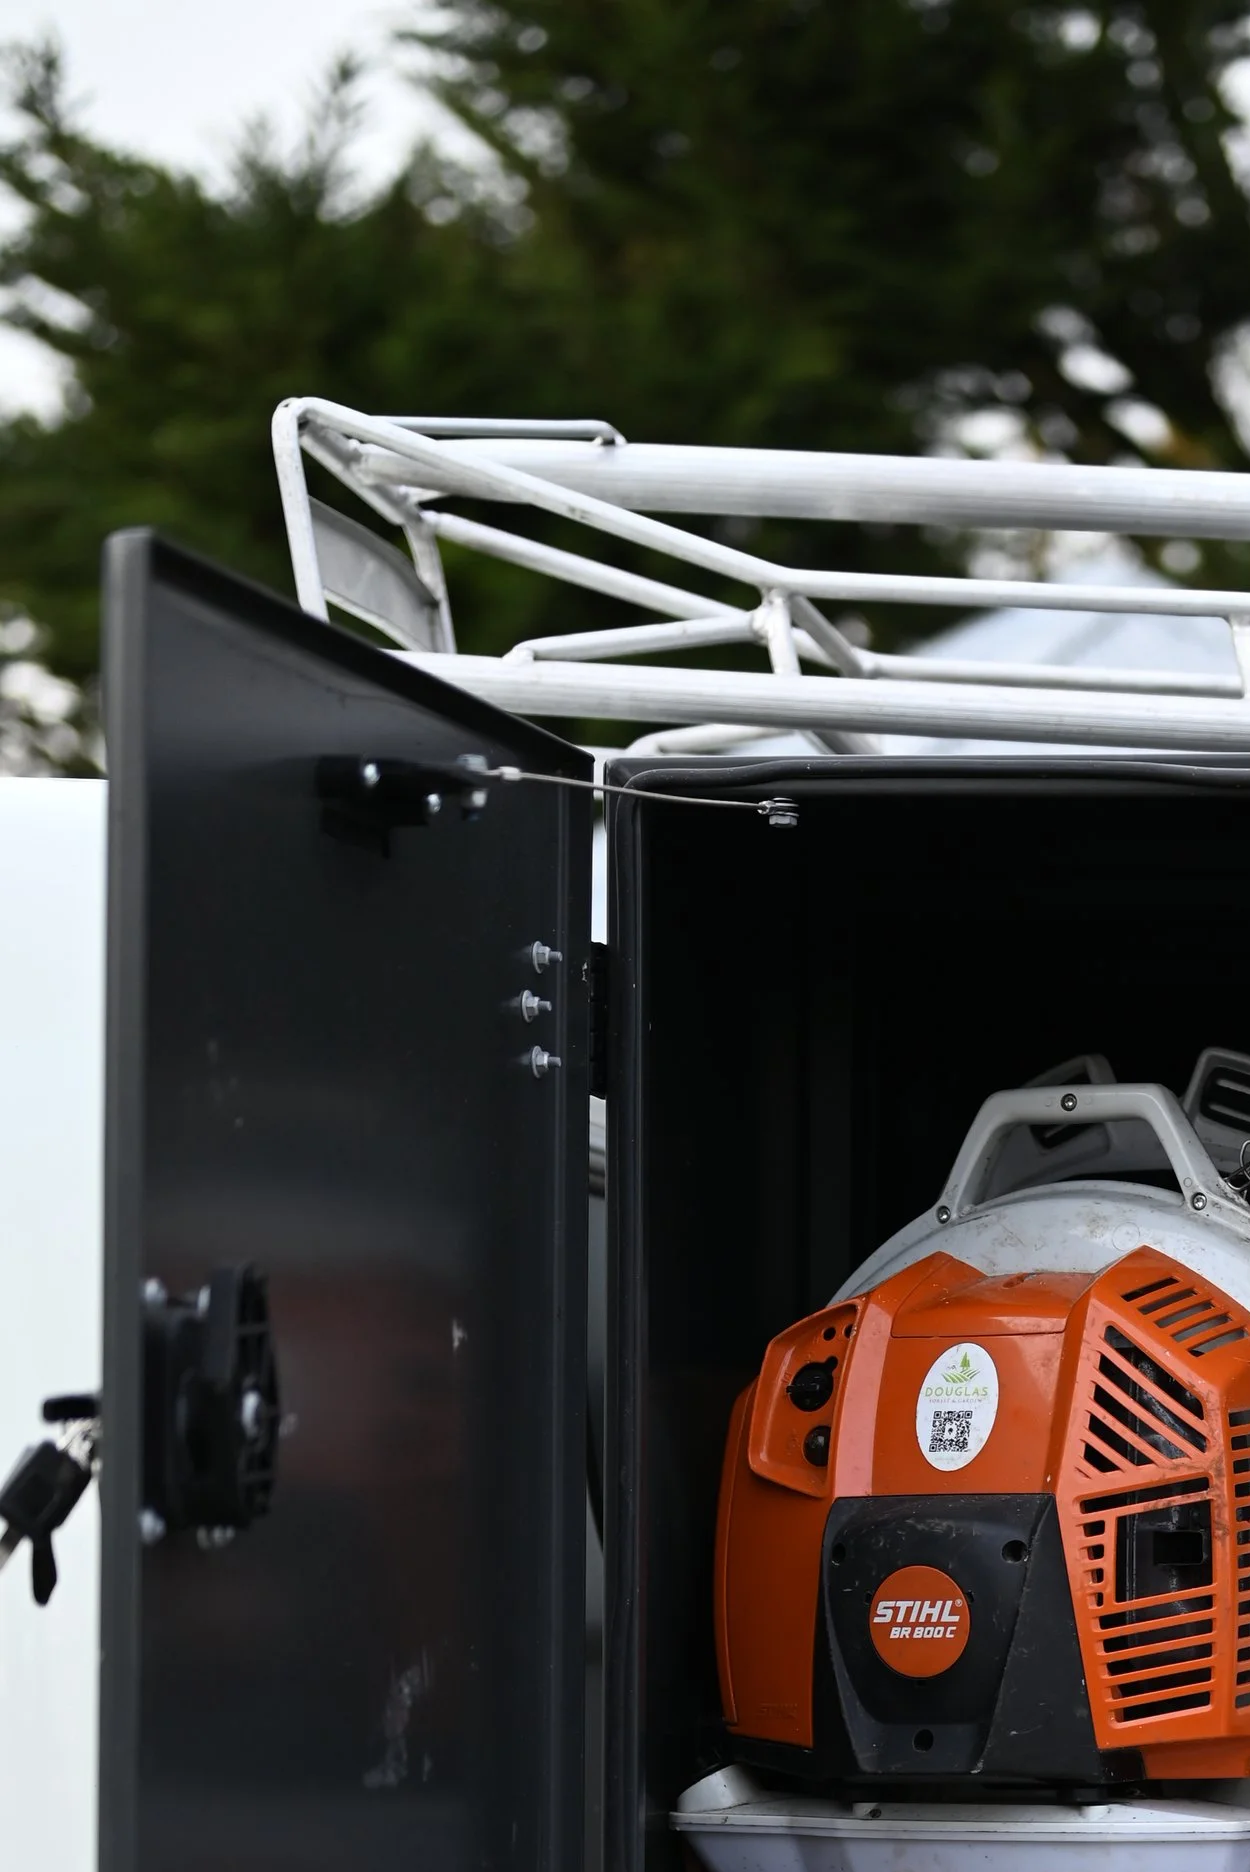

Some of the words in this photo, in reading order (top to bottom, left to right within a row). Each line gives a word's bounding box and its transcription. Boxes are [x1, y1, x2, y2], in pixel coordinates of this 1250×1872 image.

[925, 1387, 988, 1397] DOUGLAS
[889, 1626, 912, 1639] BR
[913, 1626, 944, 1639] 800
[945, 1626, 957, 1638] C
